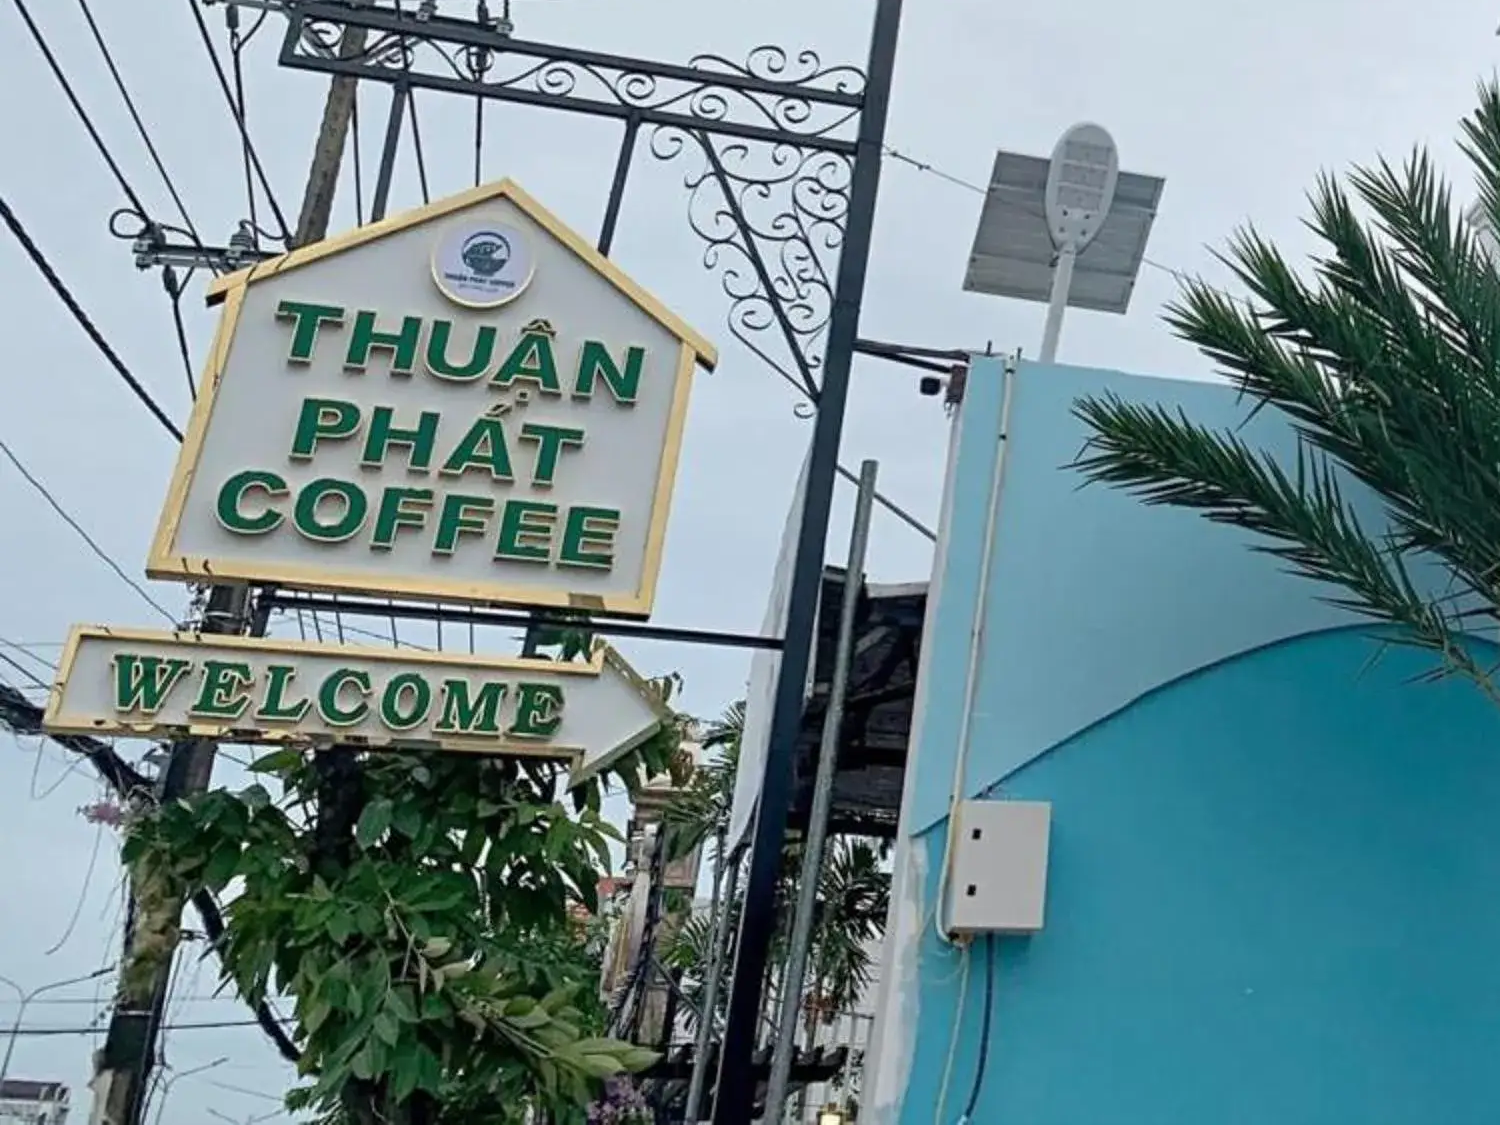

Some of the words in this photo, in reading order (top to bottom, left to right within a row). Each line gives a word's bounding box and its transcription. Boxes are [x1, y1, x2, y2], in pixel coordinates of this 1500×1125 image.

[275, 300, 645, 406] THUẬN
[289, 398, 585, 487] PHÁT
[216, 470, 621, 570] COFFEE
[112, 653, 566, 737] WELCOME
